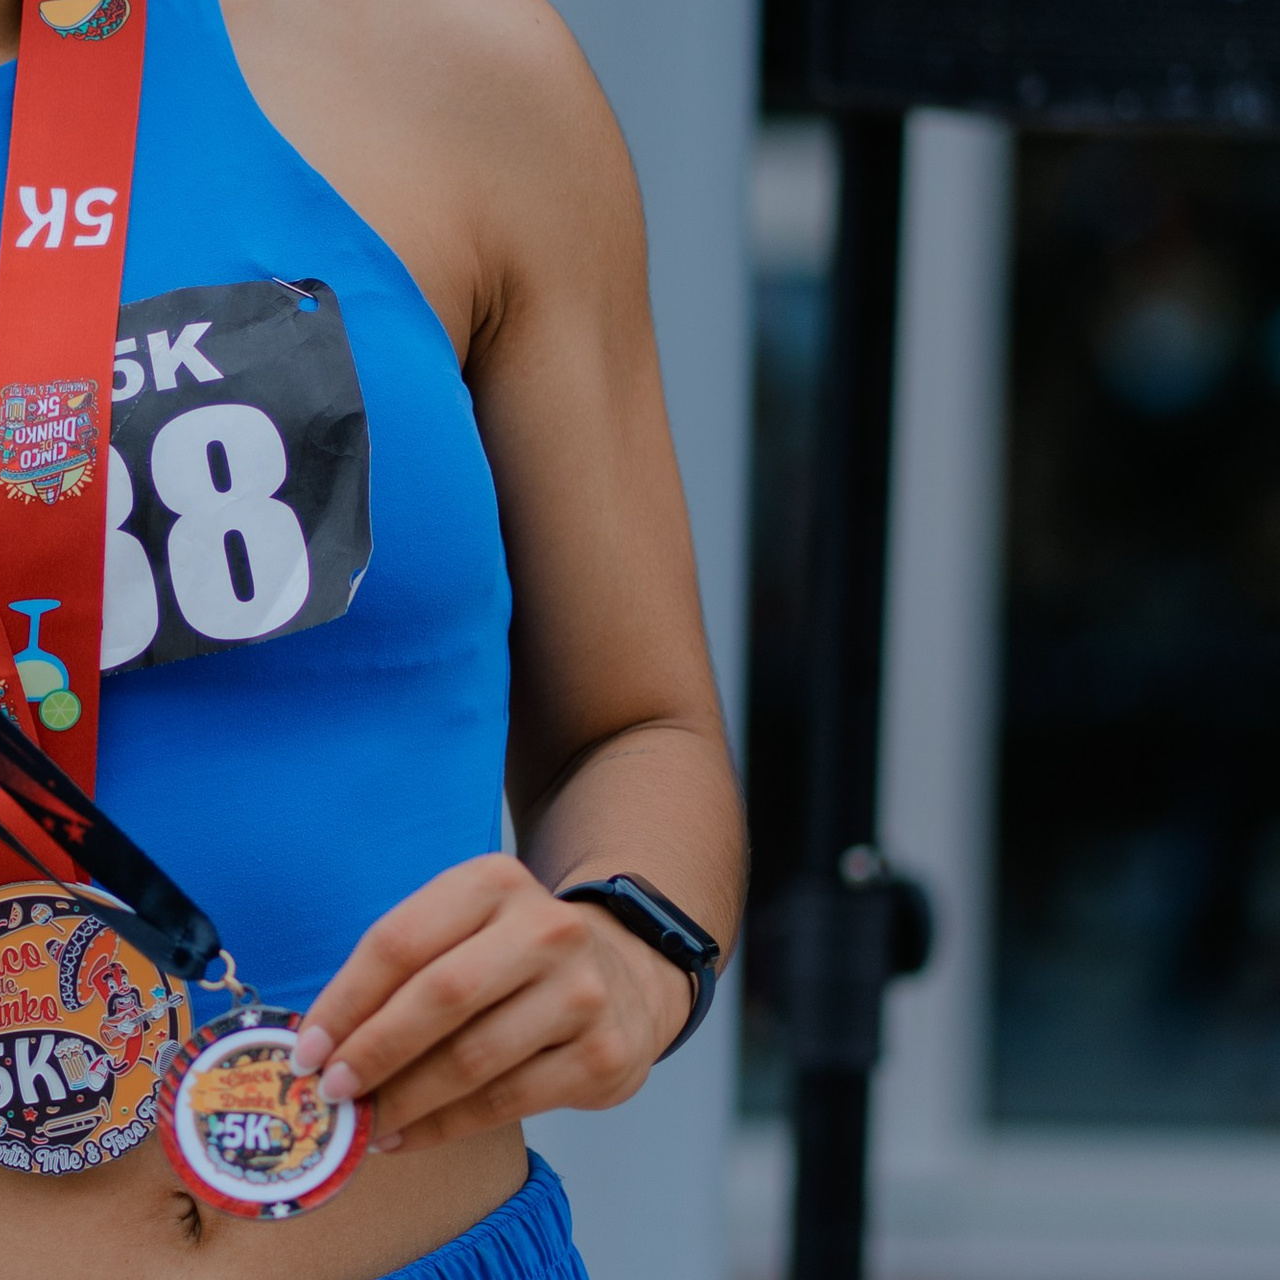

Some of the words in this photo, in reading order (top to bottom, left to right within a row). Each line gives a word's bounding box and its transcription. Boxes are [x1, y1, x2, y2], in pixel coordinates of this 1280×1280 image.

[16, 187, 118, 248] 5K
[111, 321, 225, 402] 5K
[37, 395, 61, 418] 5K
[14, 416, 78, 444] DRINKO
[20, 441, 68, 469] CINCO
[35, 1145, 84, 1173] Mile
[85, 1142, 102, 1163] &
[101, 1121, 147, 1157] Taco
[223, 1113, 272, 1150] 5K
